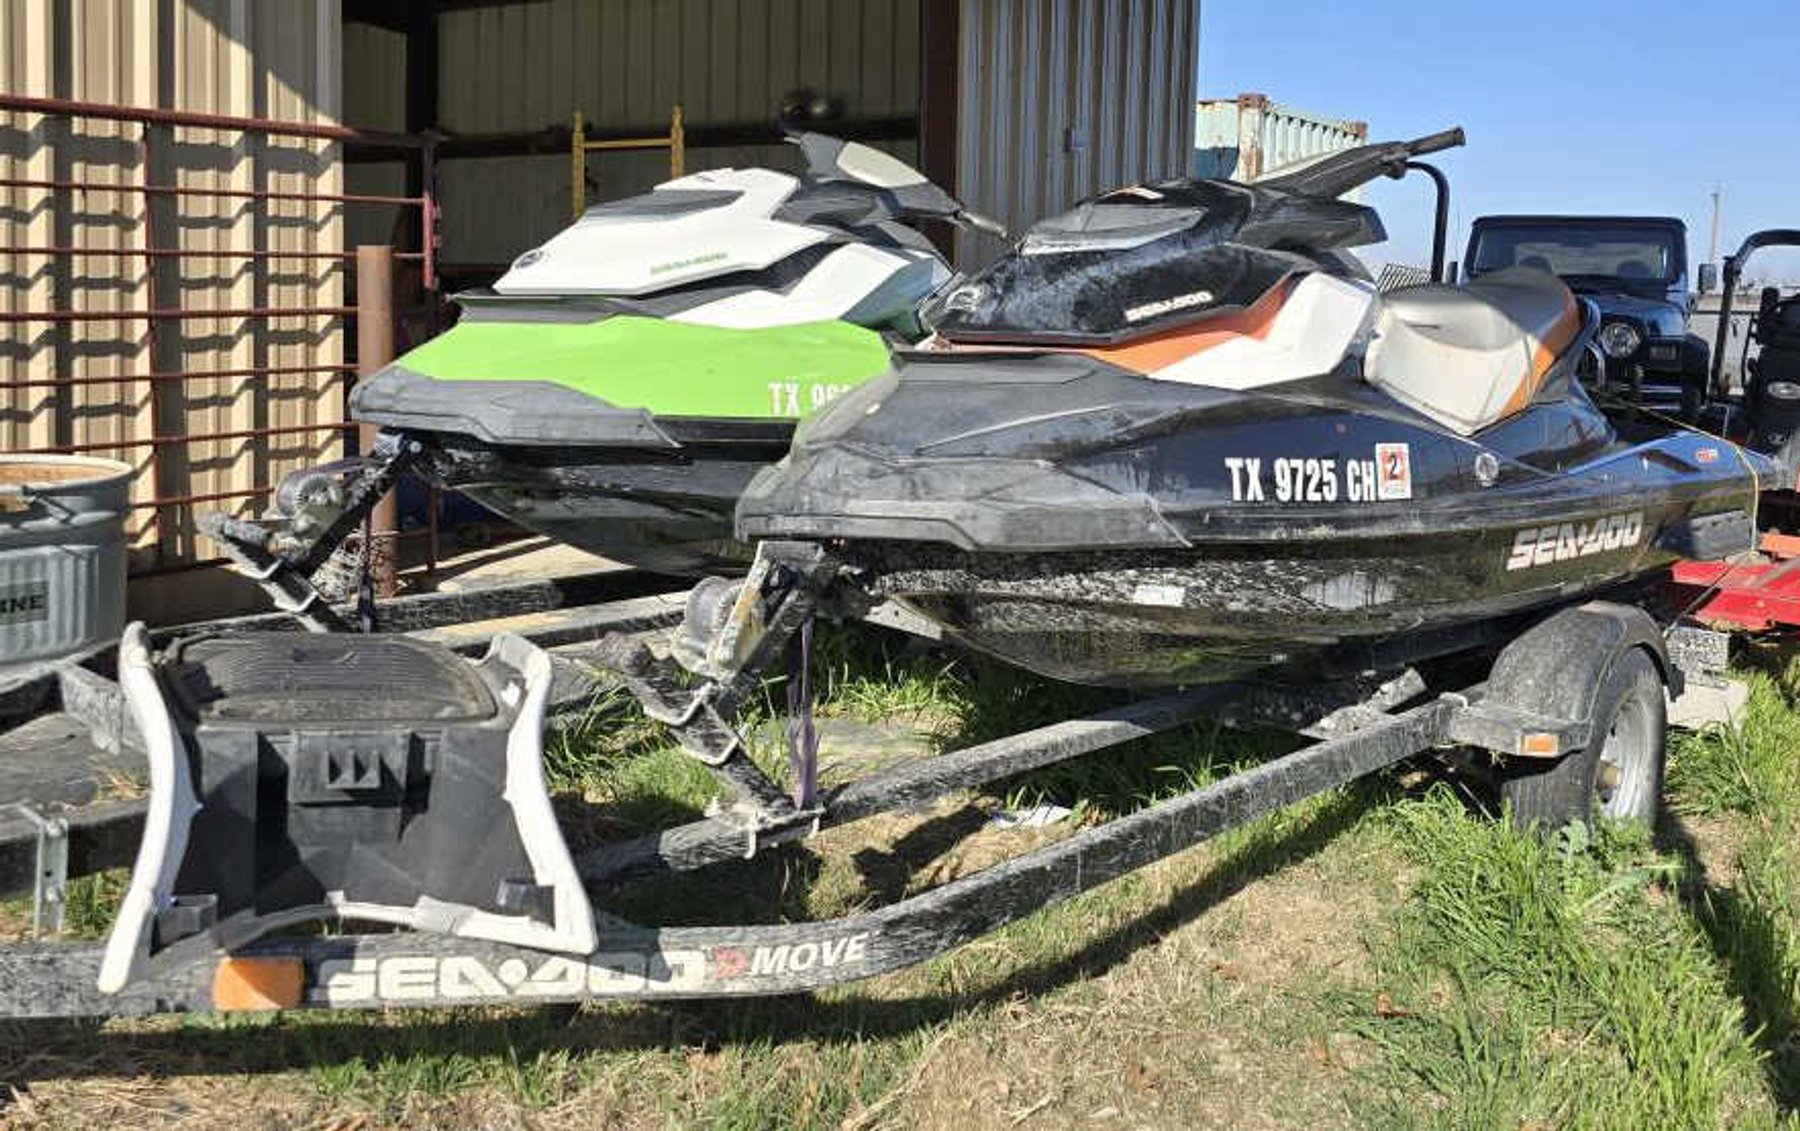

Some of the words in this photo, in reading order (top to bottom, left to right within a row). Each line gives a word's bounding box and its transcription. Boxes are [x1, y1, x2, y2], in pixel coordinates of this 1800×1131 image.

[768, 382, 799, 417] TX
[1224, 457, 1265, 501] TX
[1273, 457, 1338, 501] 9725
[1346, 459, 1376, 501] CH
[1388, 453, 1401, 480] 2
[752, 932, 868, 976] MOVE
